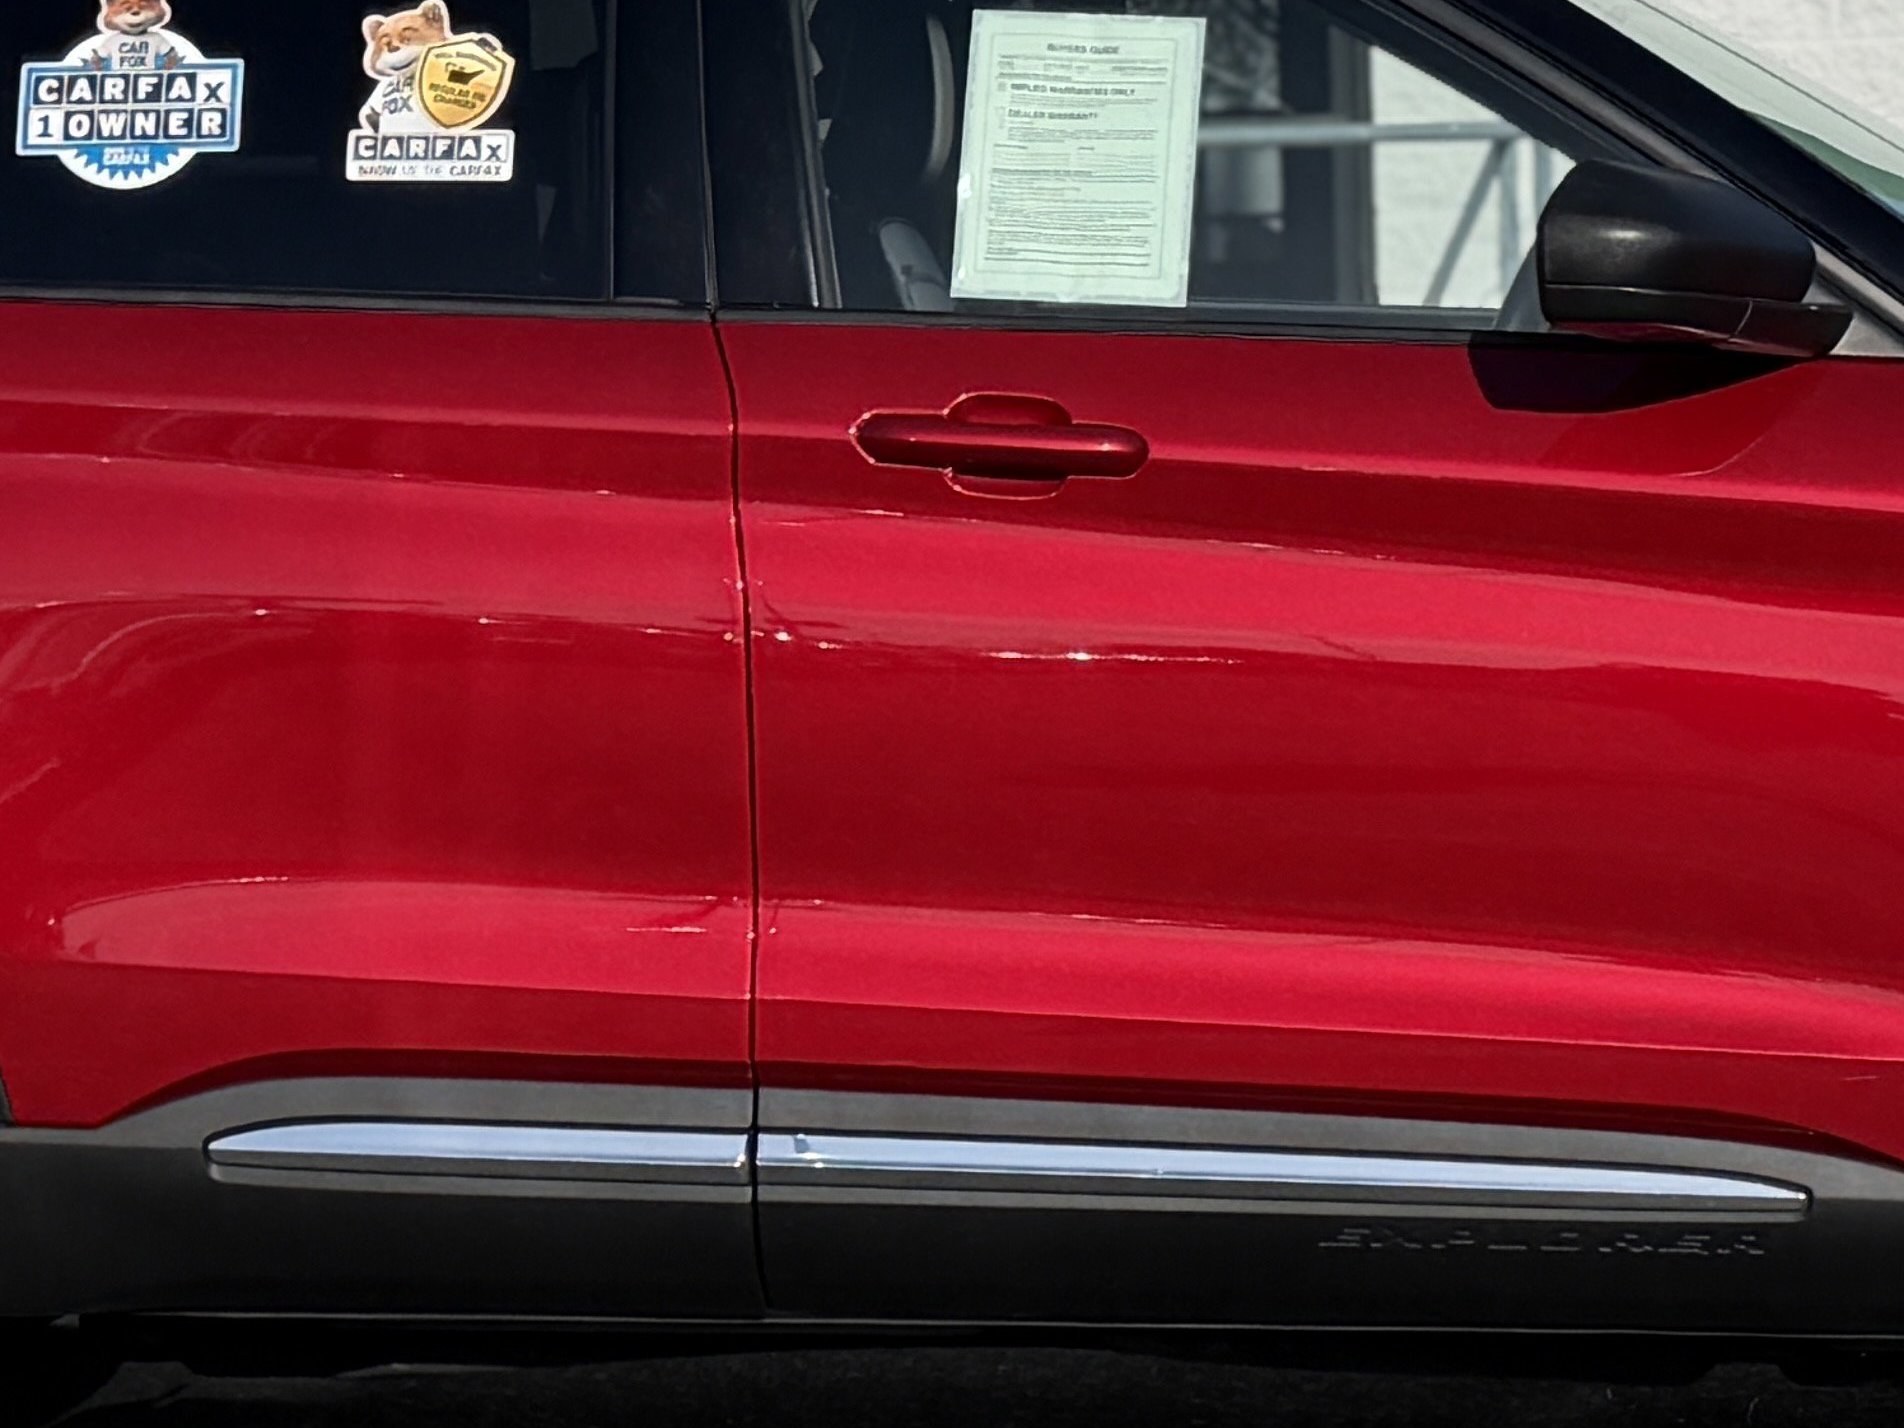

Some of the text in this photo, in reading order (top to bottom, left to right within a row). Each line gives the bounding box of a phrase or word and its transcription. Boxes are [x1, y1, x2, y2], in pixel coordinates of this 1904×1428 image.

[118, 41, 150, 54] CAR
[118, 56, 148, 68] FOX
[36, 75, 226, 104] CARFAX
[381, 94, 414, 115] FOX
[35, 110, 224, 138] 1 OWNER
[357, 137, 503, 163] CARFAX
